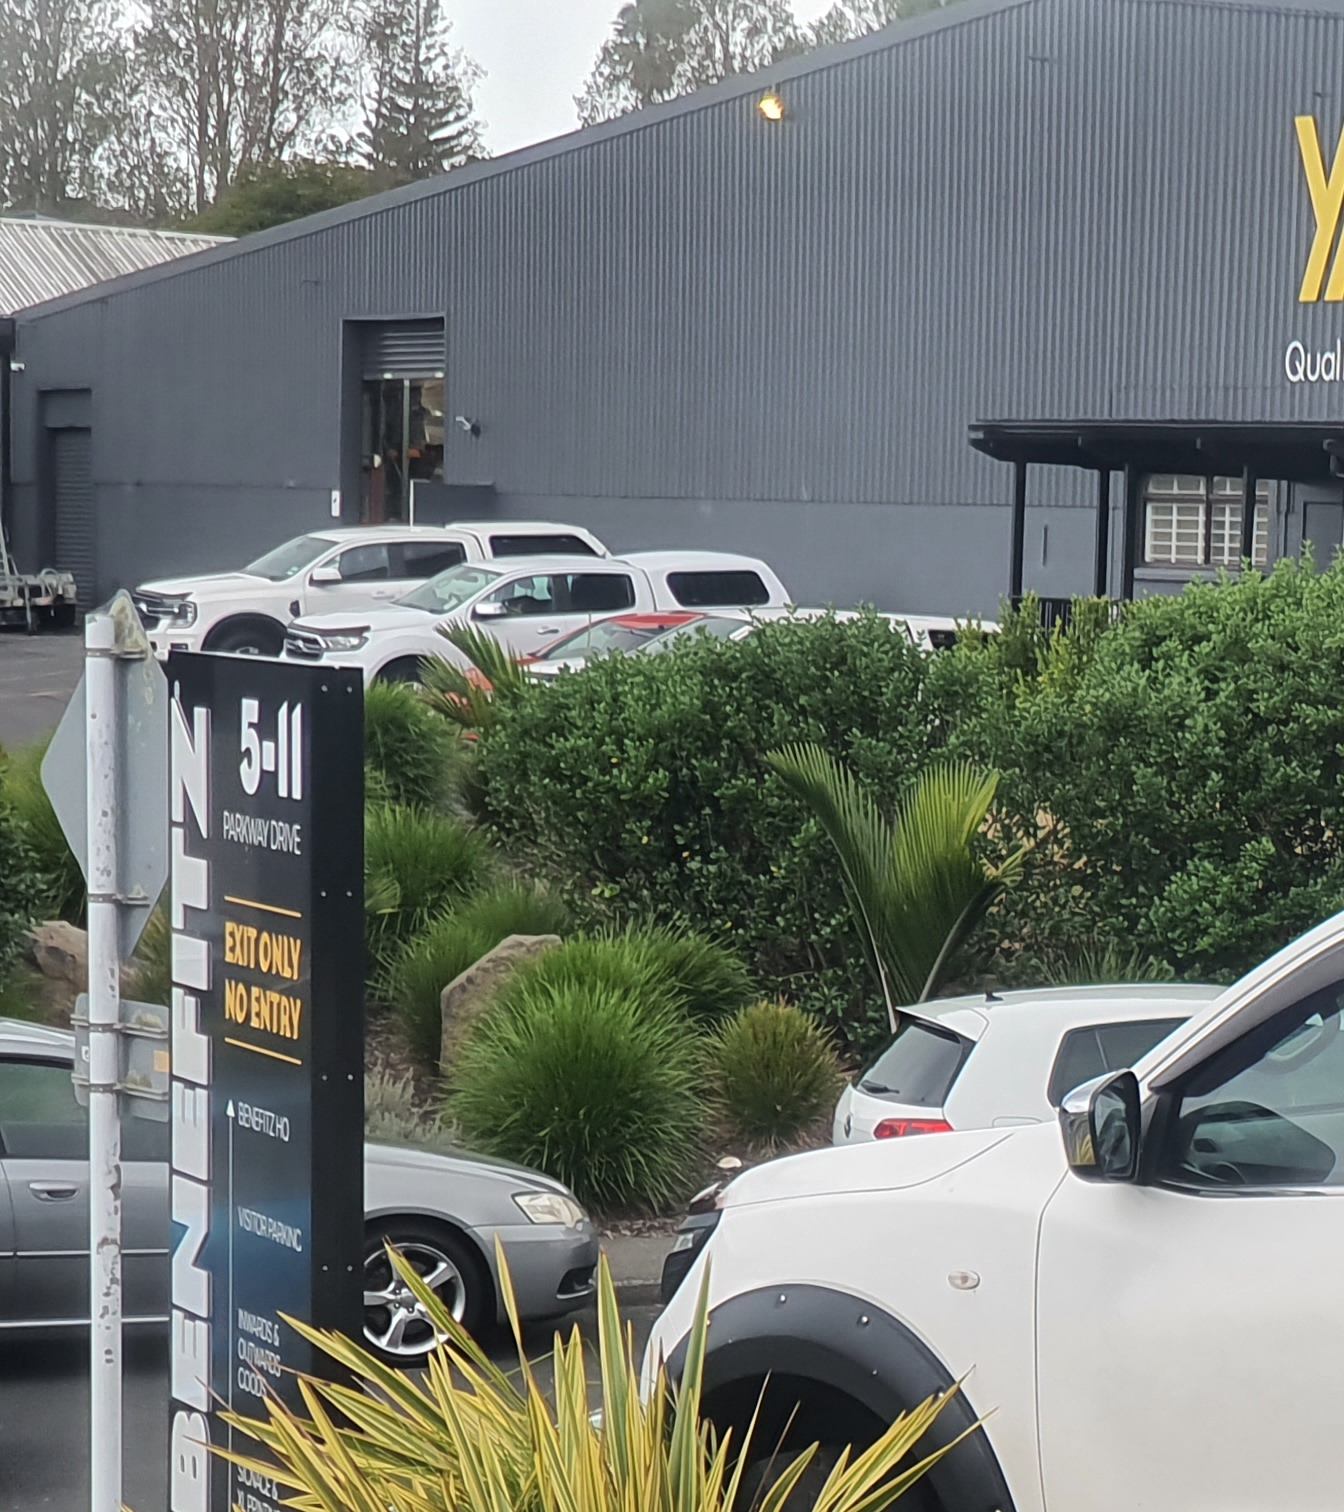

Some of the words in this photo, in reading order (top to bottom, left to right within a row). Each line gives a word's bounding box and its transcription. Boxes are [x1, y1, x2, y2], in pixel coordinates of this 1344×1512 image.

[239, 698, 302, 800] 5-11
[223, 810, 269, 848] PARKWAY
[270, 819, 302, 855] DRIVE
[224, 921, 258, 969] EXIT
[258, 930, 301, 981] ONLY
[224, 978, 248, 1024] NO
[250, 985, 301, 1040] ENTRY
[238, 1101, 276, 1138] BENEFITZ
[237, 1205, 268, 1238] VISITOR
[267, 1217, 302, 1253] PARKING
[238, 1308, 273, 1344] INWARDS
